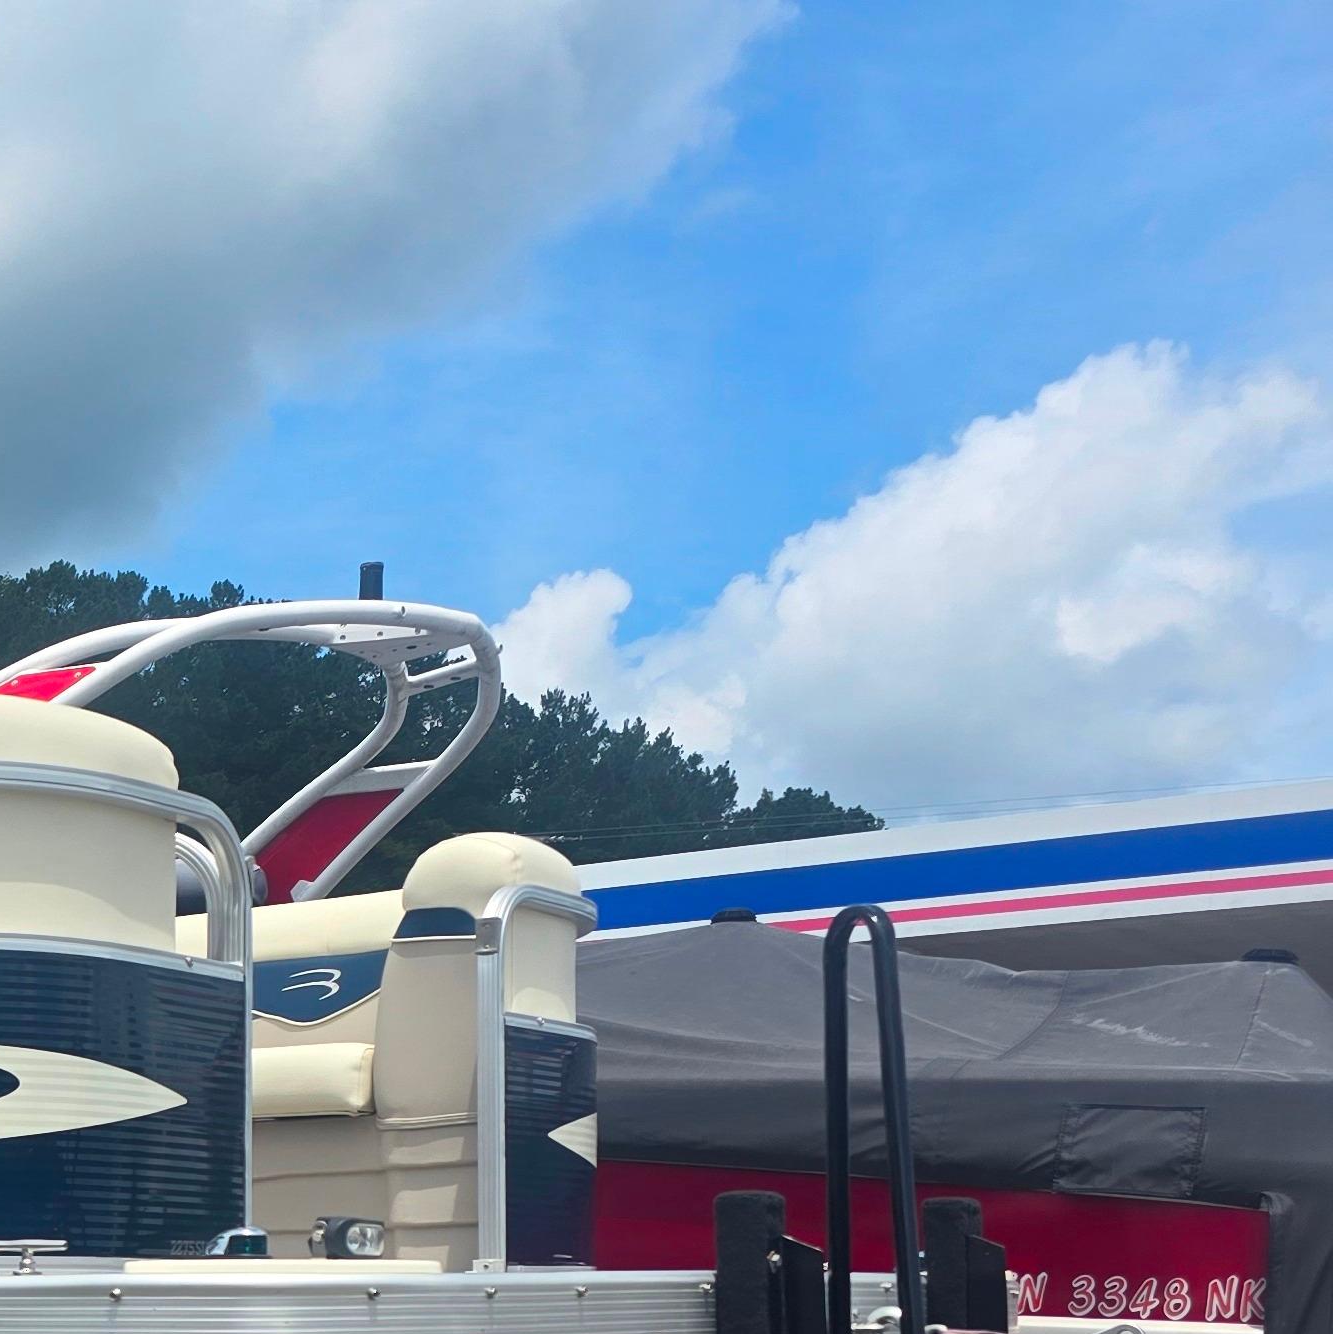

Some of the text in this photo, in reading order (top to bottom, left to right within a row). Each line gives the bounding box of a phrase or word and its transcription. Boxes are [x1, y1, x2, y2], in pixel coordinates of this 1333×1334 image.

[1017, 1271, 1266, 1322] N 3348 NK
